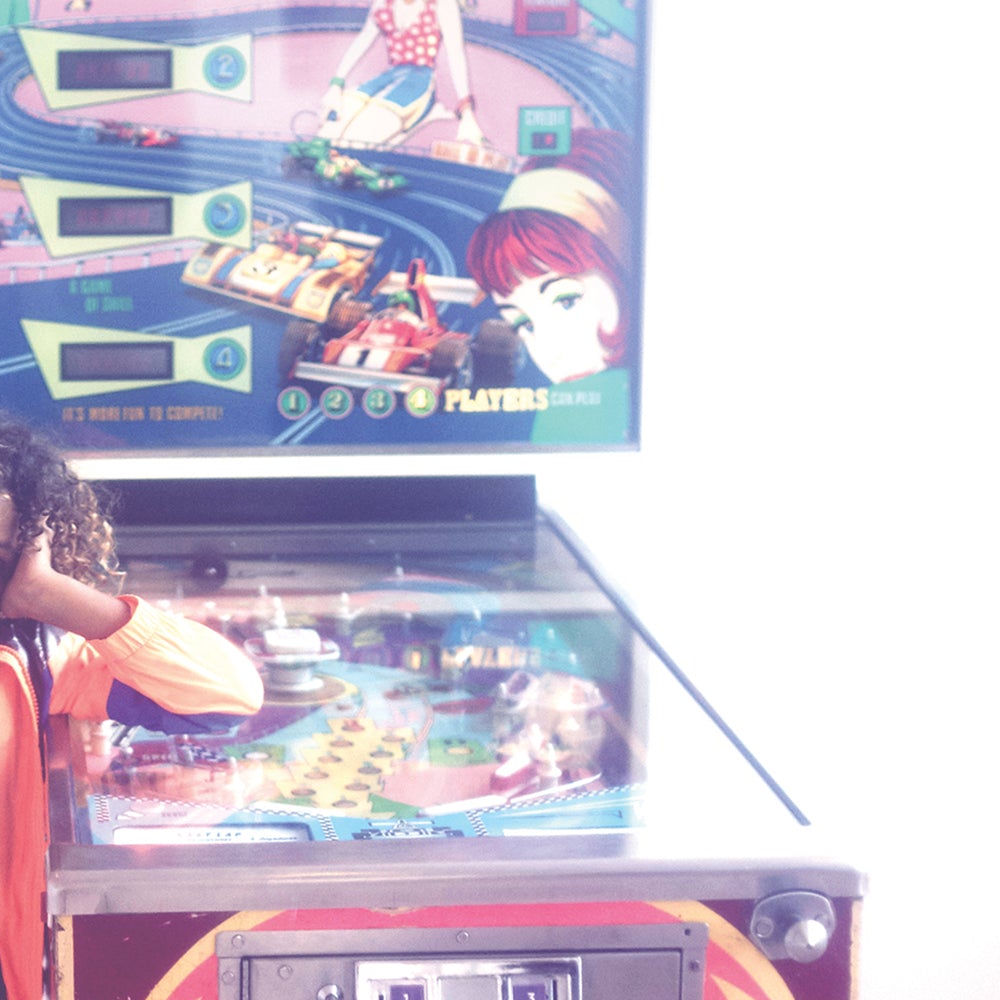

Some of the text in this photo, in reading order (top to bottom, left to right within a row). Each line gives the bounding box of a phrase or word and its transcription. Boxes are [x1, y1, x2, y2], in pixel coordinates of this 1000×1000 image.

[217, 54, 234, 78] 2
[289, 392, 298, 410] 1
[328, 391, 344, 409] 2
[370, 392, 386, 409] 3
[409, 388, 428, 409] 4
[444, 387, 549, 413] PLAYERS
